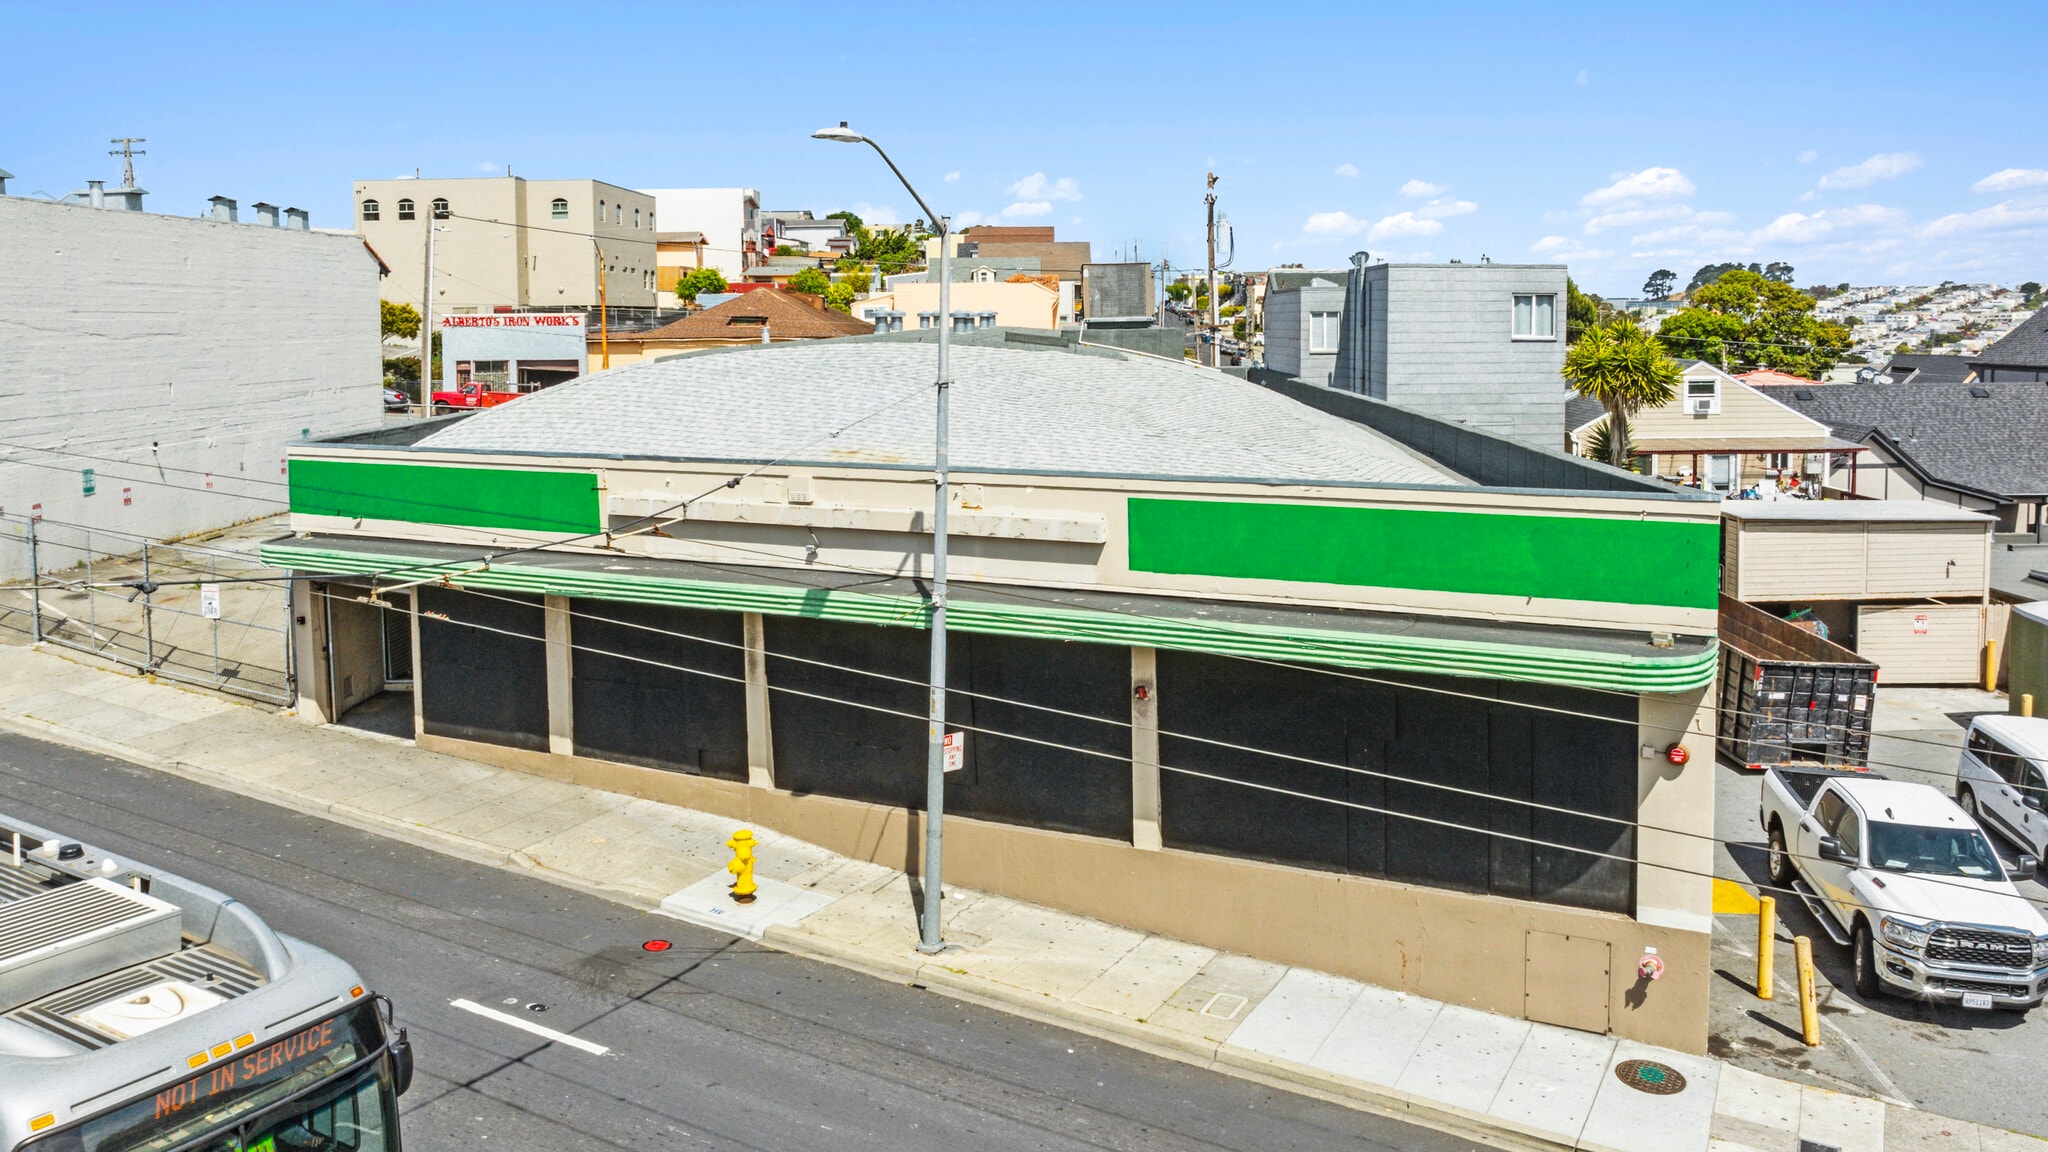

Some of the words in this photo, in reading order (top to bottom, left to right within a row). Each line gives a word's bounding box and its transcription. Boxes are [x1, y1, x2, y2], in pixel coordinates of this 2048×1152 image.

[443, 315, 500, 327] ALBERTO'S
[503, 316, 530, 327] IRON
[533, 315, 580, 326] WORK'S
[943, 736, 952, 745] NO
[1959, 939, 2007, 951] RAM
[155, 1076, 202, 1119] NOT
[209, 1062, 235, 1096] IN
[242, 1018, 334, 1080] SERVICE
